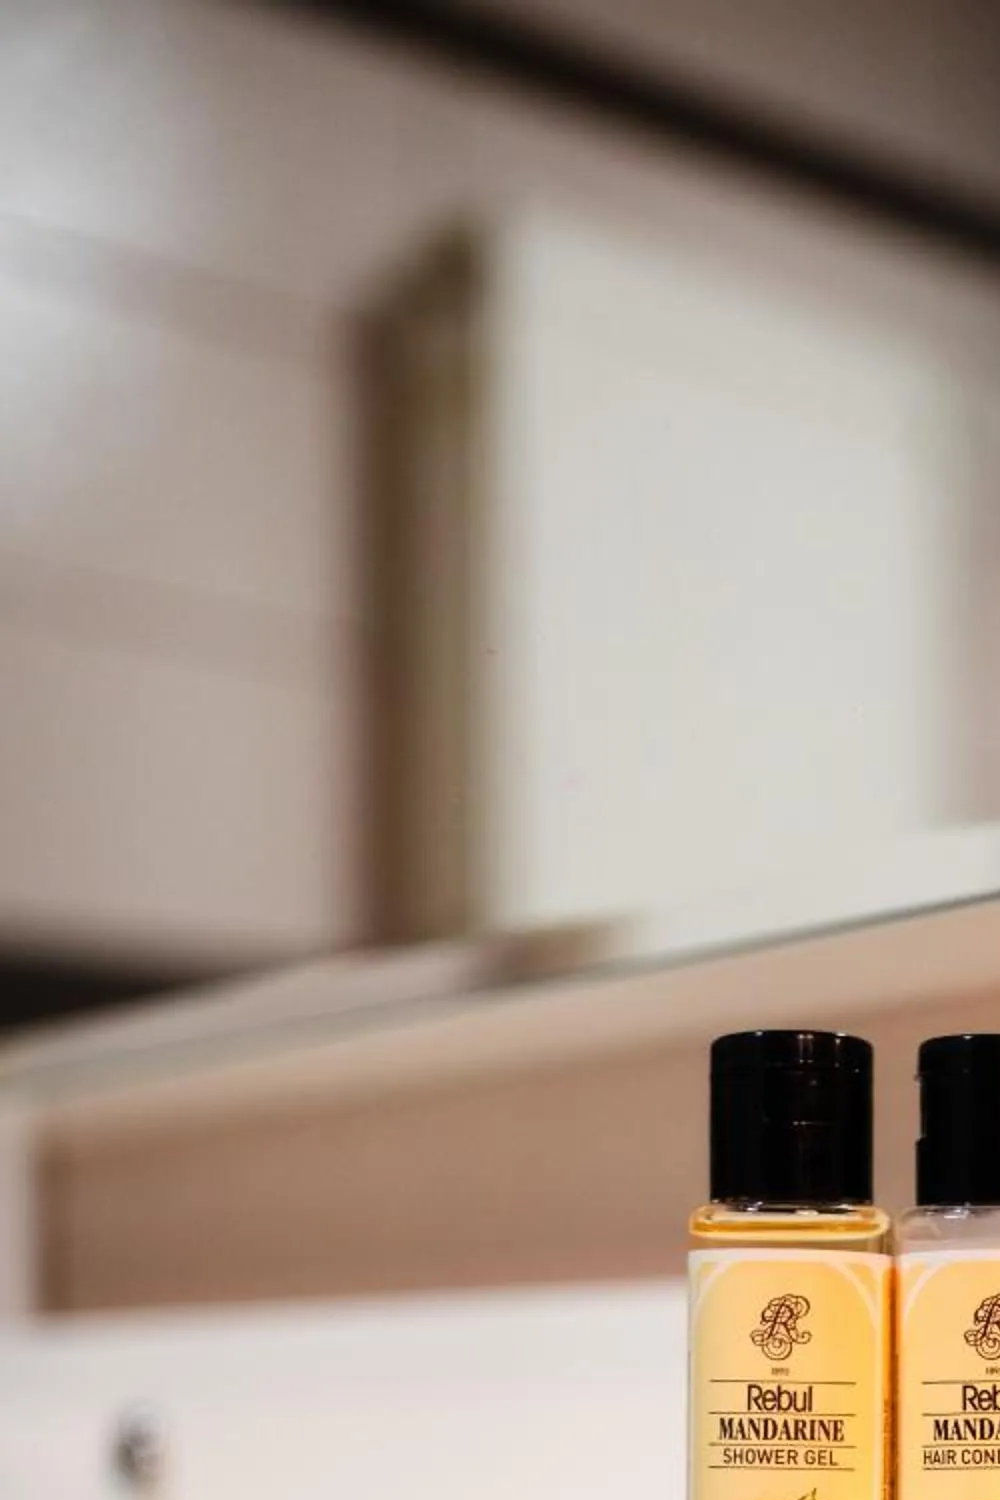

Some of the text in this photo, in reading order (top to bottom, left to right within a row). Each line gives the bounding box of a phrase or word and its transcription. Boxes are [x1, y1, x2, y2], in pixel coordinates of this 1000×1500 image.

[746, 1383, 814, 1413] Rebul
[718, 1416, 846, 1443] MANDARINE
[722, 1446, 840, 1467] SHOWER GEL
[922, 1448, 957, 1466] HAIR
